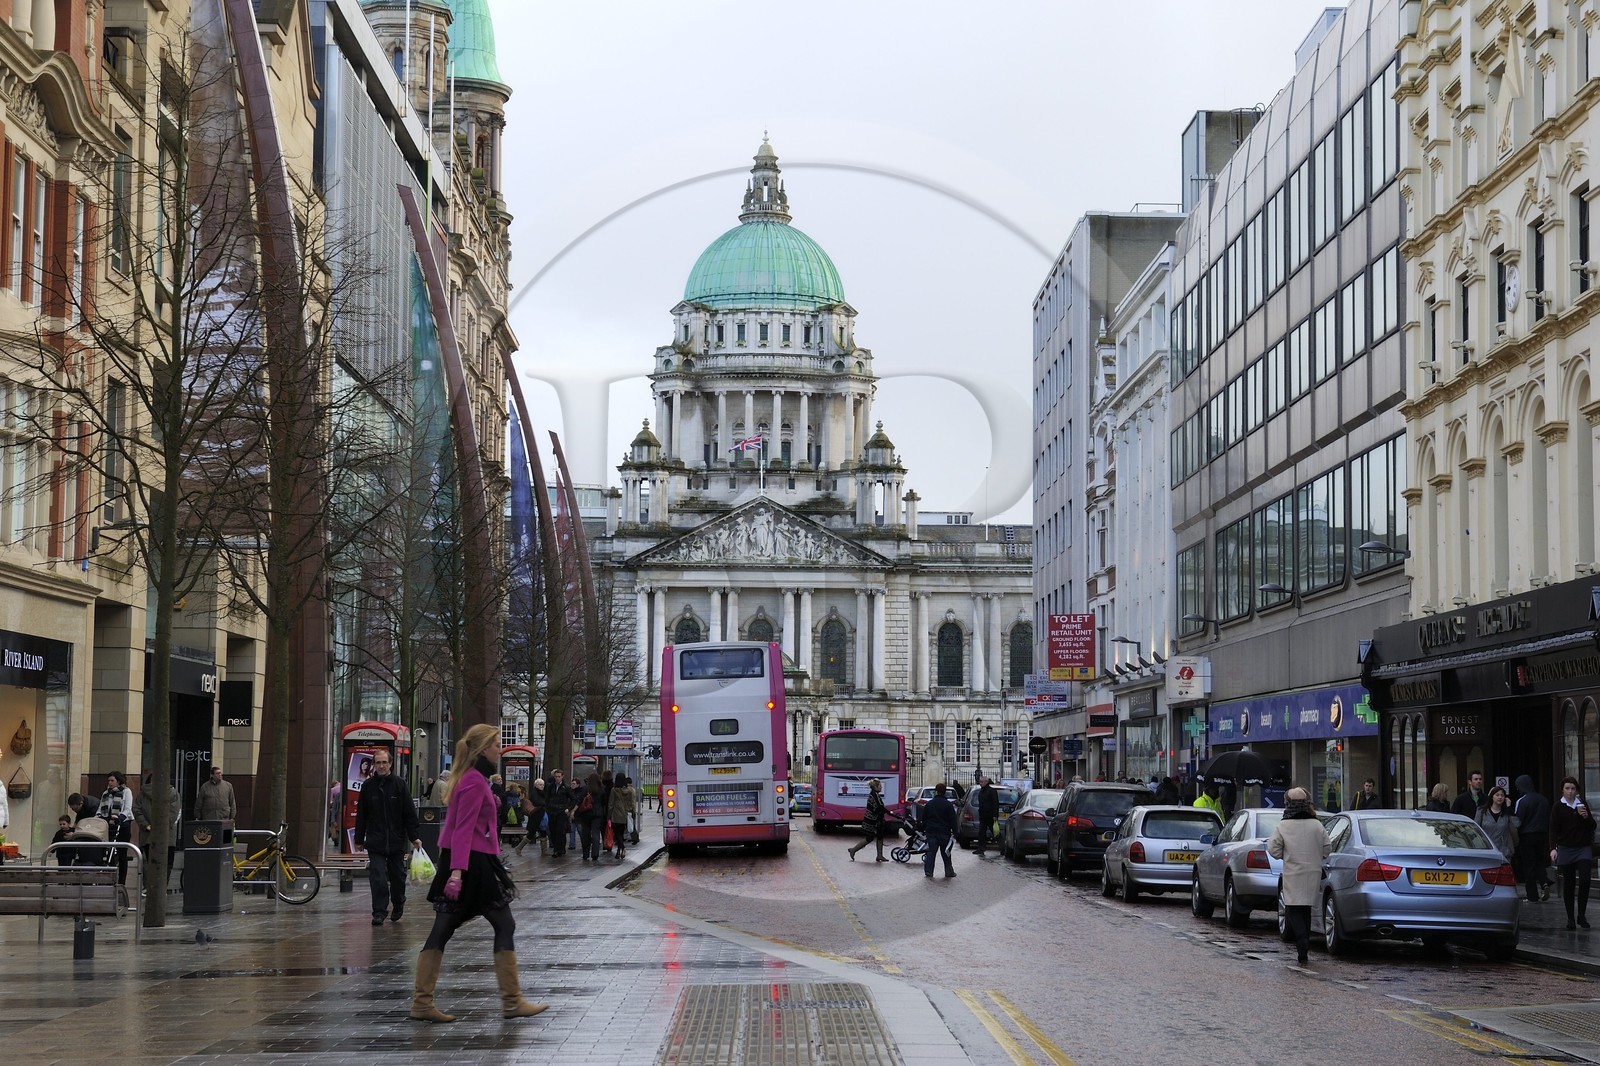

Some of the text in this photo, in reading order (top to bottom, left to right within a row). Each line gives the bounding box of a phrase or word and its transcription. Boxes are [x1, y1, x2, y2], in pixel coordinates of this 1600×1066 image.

[4, 649, 44, 671] RIVER ISLAND
[1566, 656, 1600, 678] WAREHO
[202, 674, 216, 693] next
[1260, 712, 1272, 728] beauty
[1300, 707, 1319, 726] pharmacy
[1441, 716, 1479, 724] ERNEST
[1445, 726, 1476, 735] JONES
[1443, 873, 1455, 882] 27
